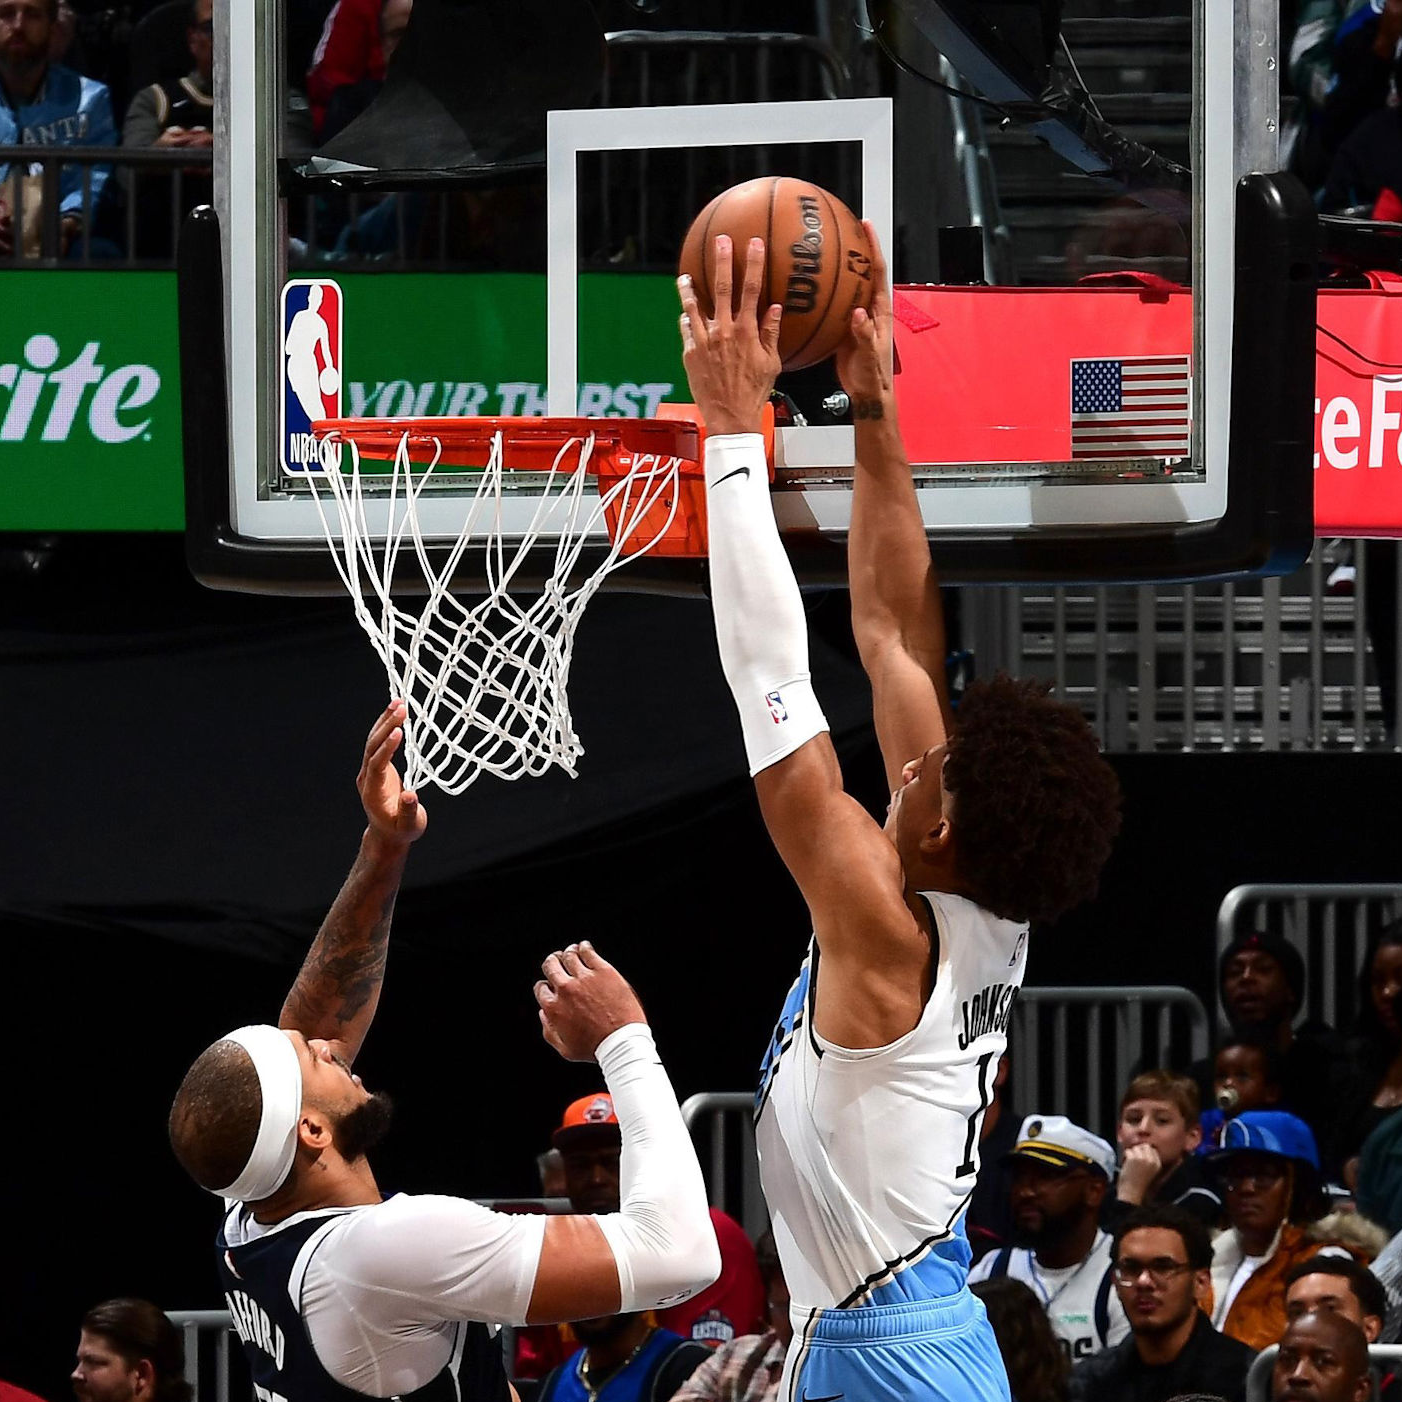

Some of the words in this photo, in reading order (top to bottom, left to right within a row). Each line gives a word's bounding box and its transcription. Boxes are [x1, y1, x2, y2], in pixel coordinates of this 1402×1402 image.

[783, 195, 824, 315] Wilson
[347, 380, 489, 418] YOUR
[497, 381, 674, 420] THRST
[958, 983, 1020, 1051] JOHNSO
[955, 1052, 995, 1168] 1
